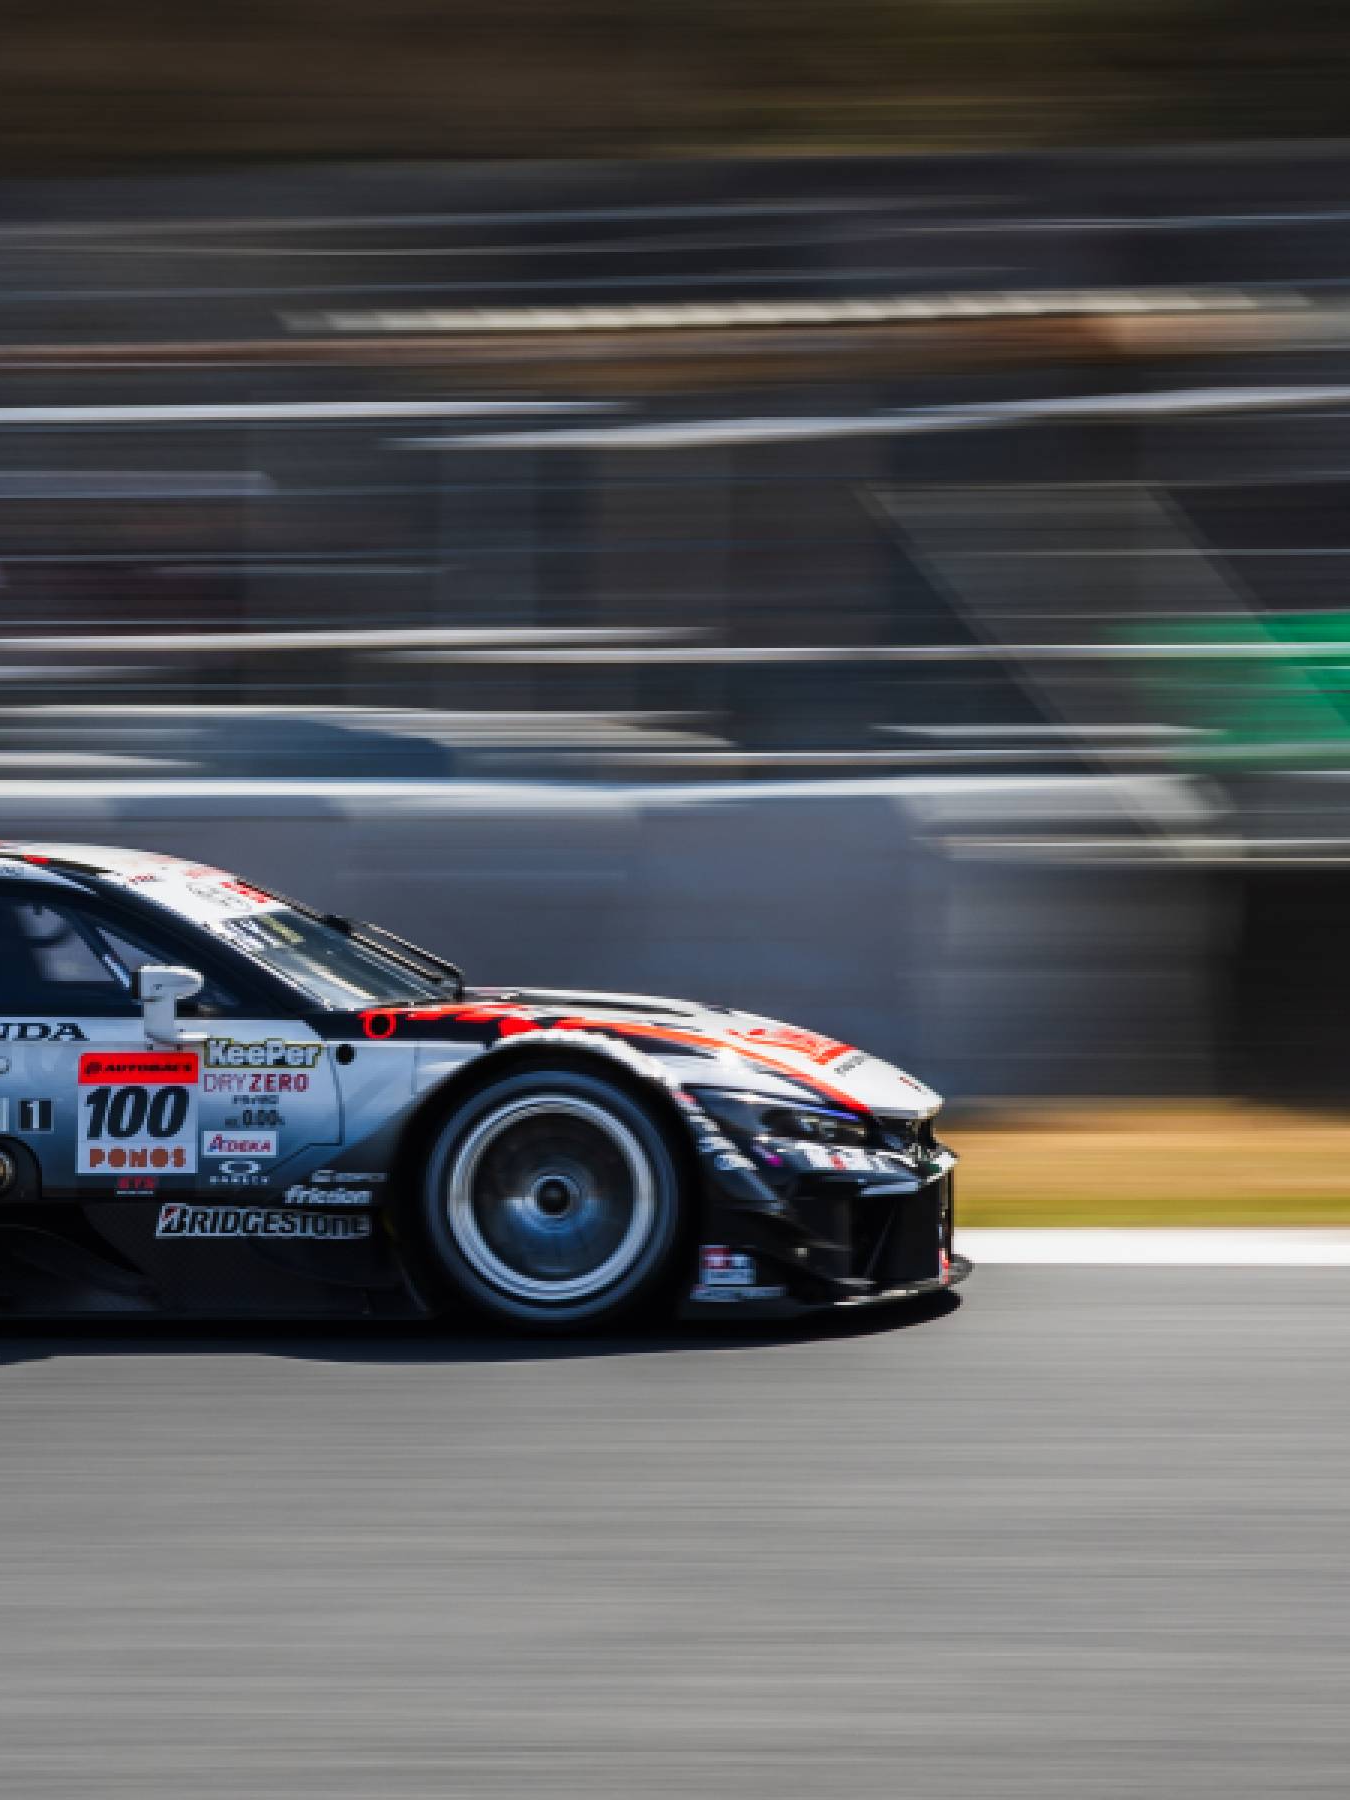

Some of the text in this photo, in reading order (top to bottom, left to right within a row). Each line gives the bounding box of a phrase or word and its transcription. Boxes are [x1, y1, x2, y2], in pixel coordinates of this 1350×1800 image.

[206, 1039, 320, 1066] KeePer
[83, 1086, 189, 1139] 100
[89, 1146, 187, 1168] PONOS
